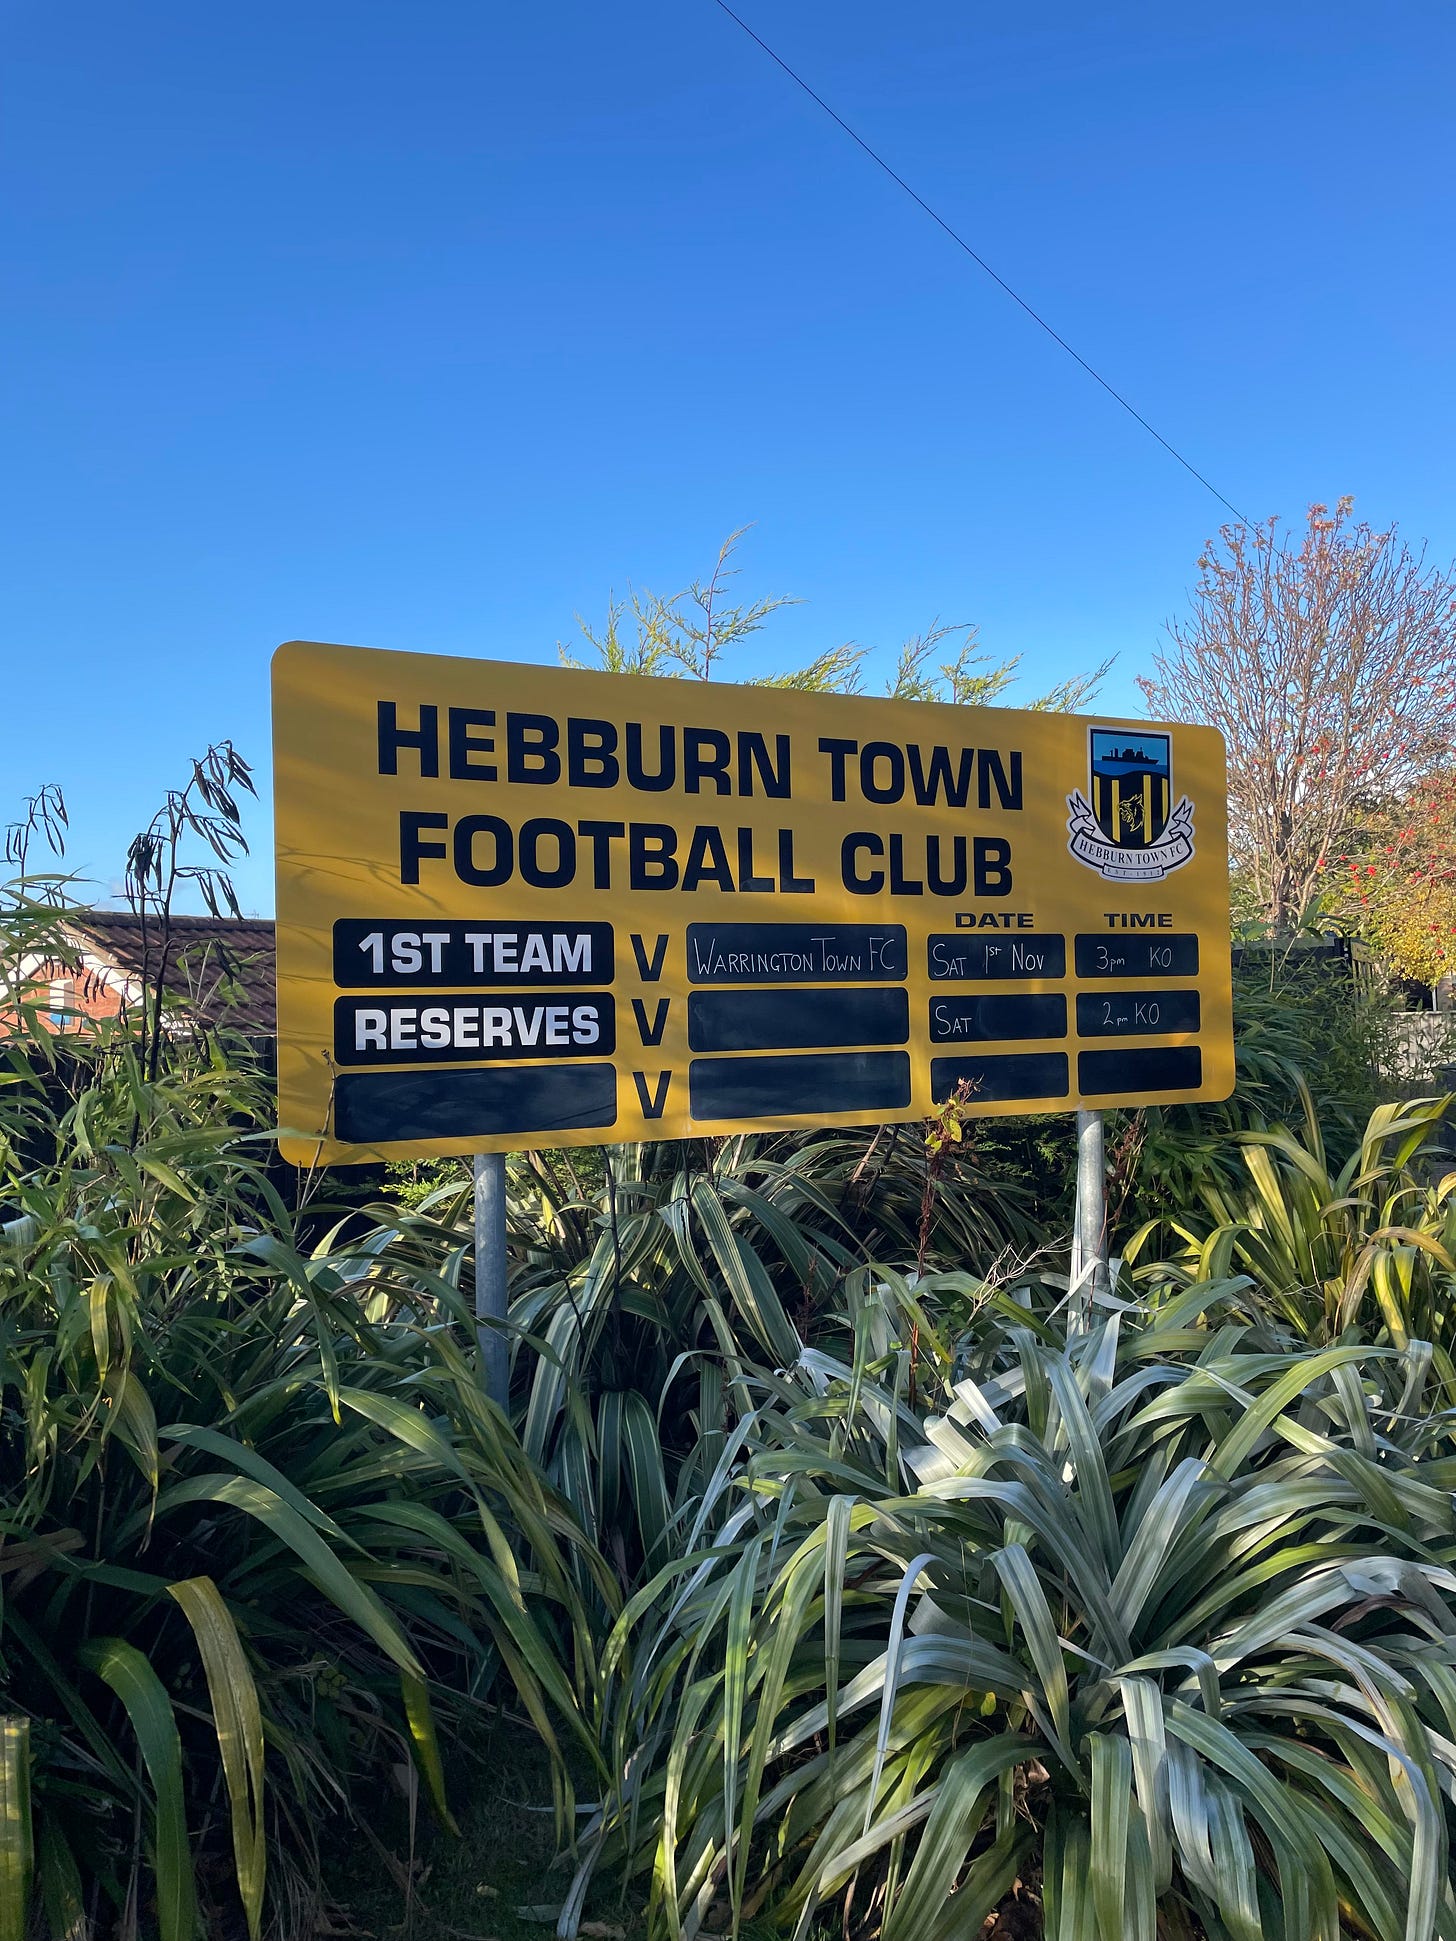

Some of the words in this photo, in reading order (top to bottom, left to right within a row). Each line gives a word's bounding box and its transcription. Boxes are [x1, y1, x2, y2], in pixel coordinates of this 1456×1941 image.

[378, 700, 792, 798] HEBBURN
[818, 737, 1023, 811] TOWN
[399, 810, 815, 894] FOOTBALL
[841, 831, 1013, 898] CLUB
[1079, 839, 1133, 865] HEBBURN
[1136, 850, 1169, 865] TOWN
[1170, 843, 1184, 857] FC
[955, 912, 1034, 928] DATE
[1104, 913, 1173, 928] TIME
[358, 932, 451, 974] 1ST
[464, 933, 592, 973] TEAM
[630, 933, 670, 982] V
[869, 937, 895, 971] FC
[1096, 946, 1125, 972] 3pm
[1149, 947, 1172, 968] KO
[354, 1006, 600, 1051] RESERVES
[631, 998, 670, 1047] V
[1135, 1003, 1160, 1025] KO
[632, 1070, 672, 1119] V
